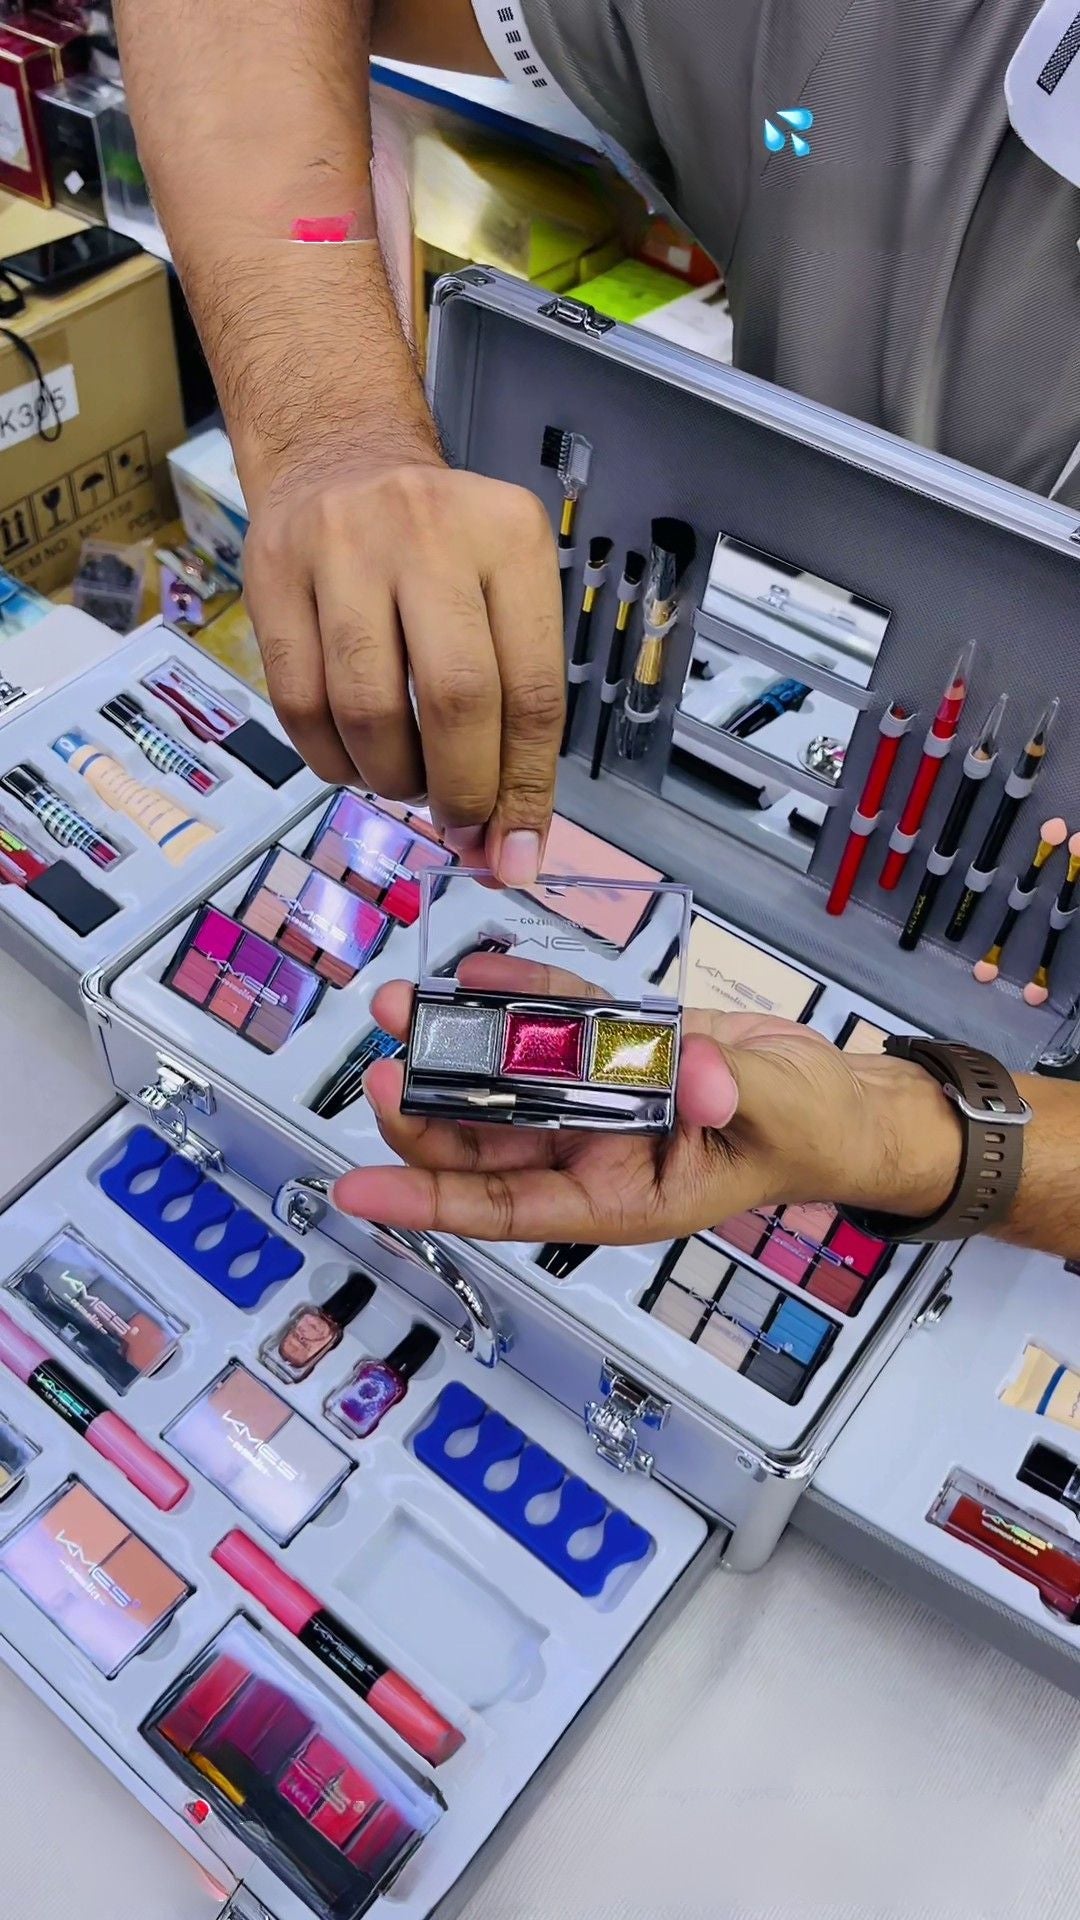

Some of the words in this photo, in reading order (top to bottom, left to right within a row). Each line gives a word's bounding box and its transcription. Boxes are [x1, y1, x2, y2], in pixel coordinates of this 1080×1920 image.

[207, 951, 282, 1006] KMES
[695, 958, 775, 1011] KMES
[60, 1270, 132, 1336] KMES
[37, 1372, 84, 1415] KMES
[222, 1409, 299, 1481] KMES
[55, 1529, 132, 1607] KMES
